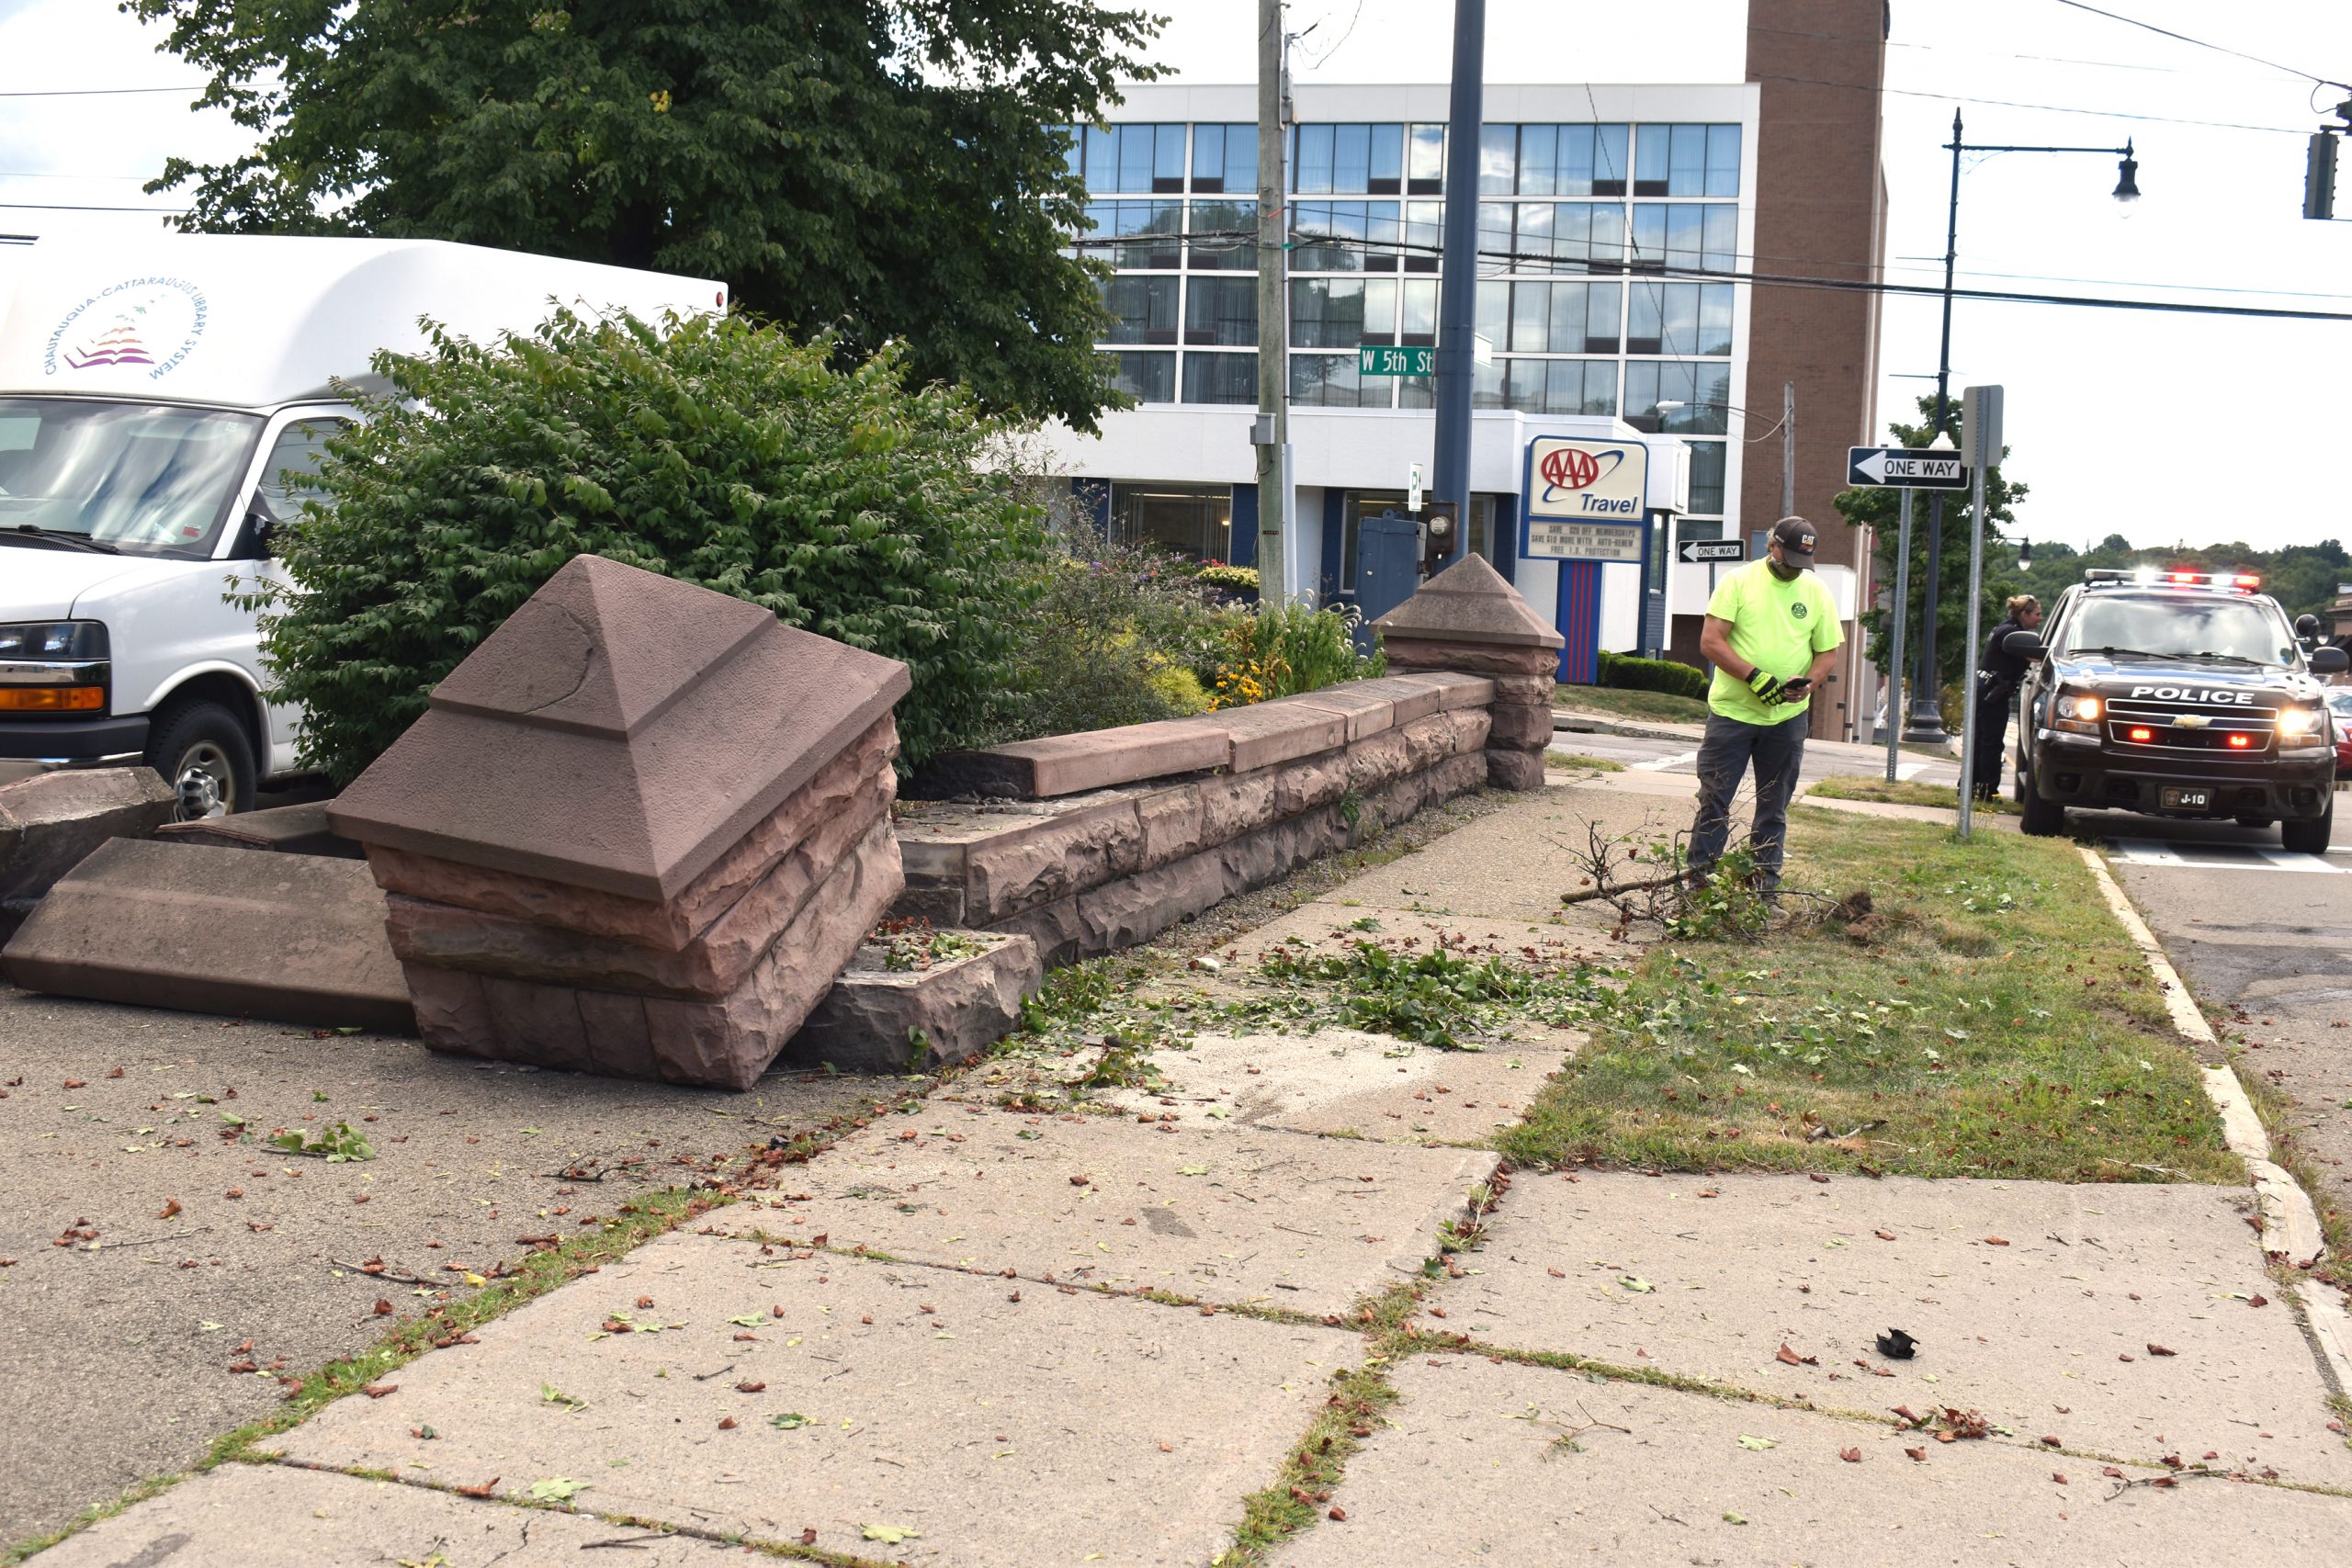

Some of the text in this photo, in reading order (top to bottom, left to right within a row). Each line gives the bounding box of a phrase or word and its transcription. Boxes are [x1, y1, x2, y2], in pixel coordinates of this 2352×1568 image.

[191, 292, 208, 336] LIBRARY
[149, 338, 197, 379] SYSTEM
[1362, 350, 1432, 373] W 5th St
[1546, 450, 1595, 488] AAA
[1884, 460, 1955, 476] ONE WAY
[1581, 493, 1638, 513] Travel
[1549, 525, 1562, 534] SAVE
[1581, 526, 1592, 535] OFF
[1595, 527, 1635, 538] MEMBERSHIPS
[1532, 535, 1634, 547] SAVE $10 MORE WITH AUTO-RENEW
[1802, 534, 1815, 546] CAT
[1550, 546, 1565, 554] FREE
[1585, 547, 1621, 557] PROTECTION
[1698, 547, 1737, 557] ONE WAY
[2131, 686, 2255, 705] POLICE
[2181, 794, 2205, 805] J-10
